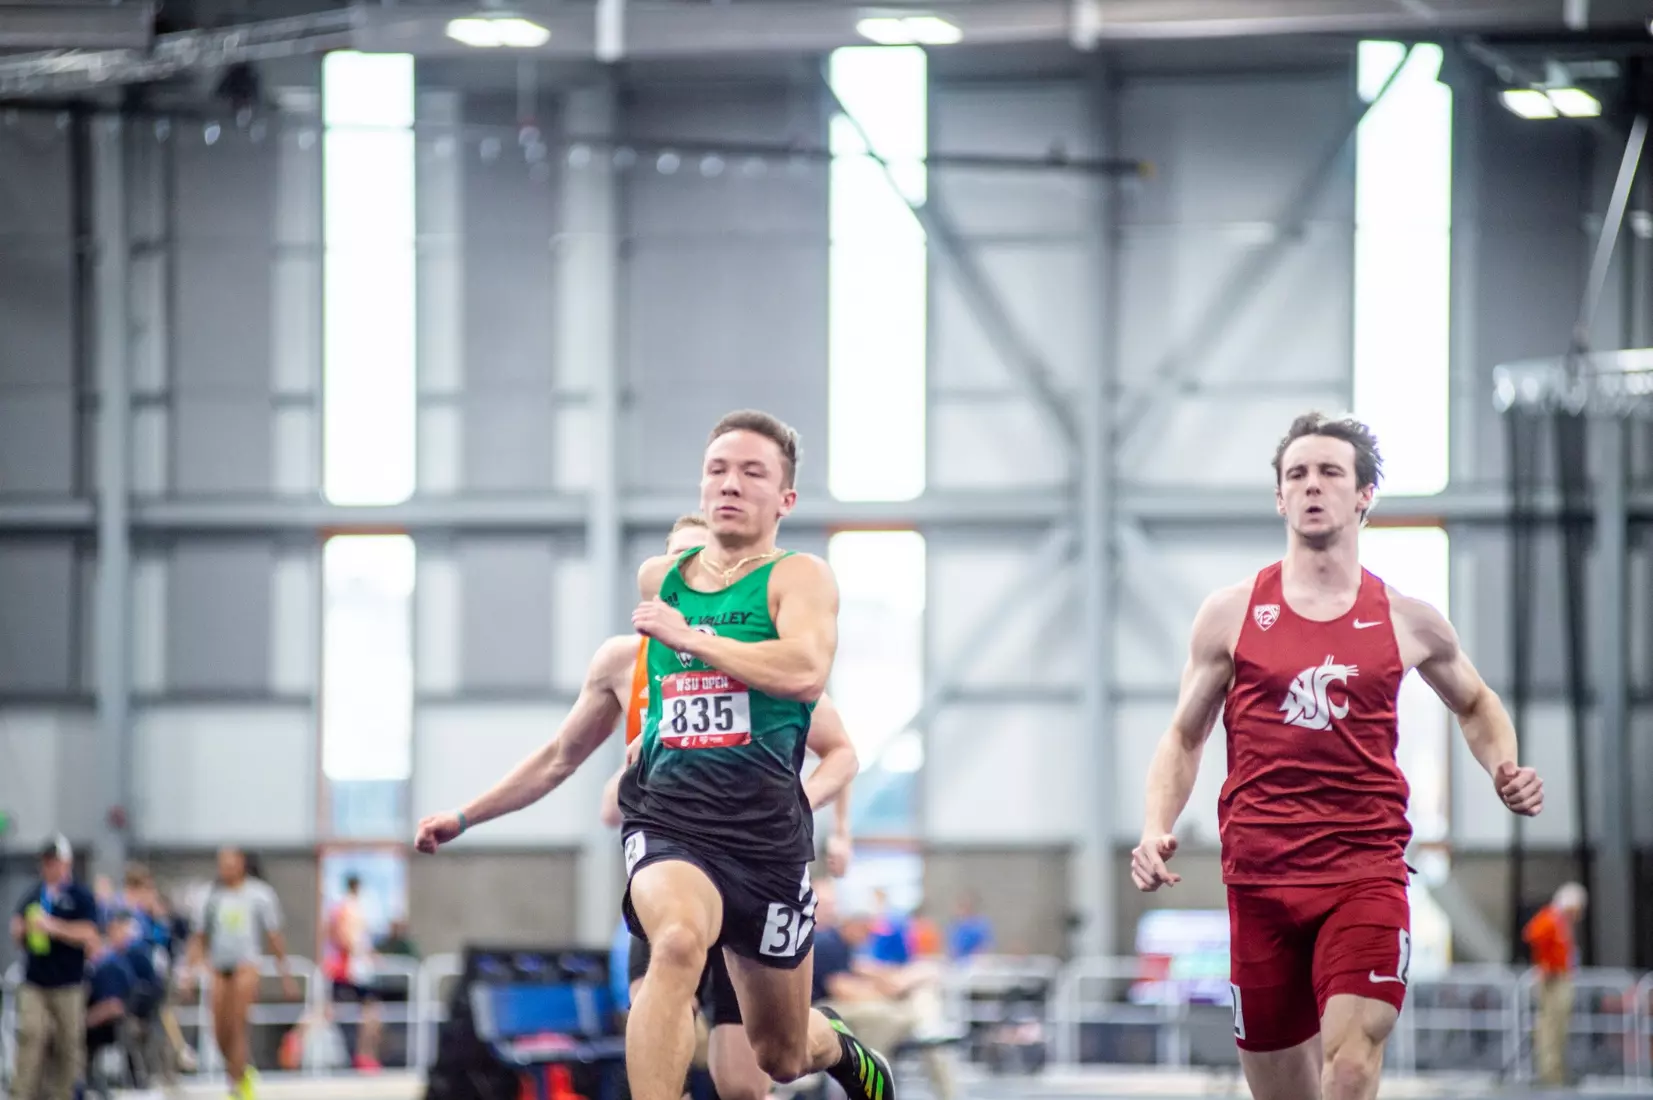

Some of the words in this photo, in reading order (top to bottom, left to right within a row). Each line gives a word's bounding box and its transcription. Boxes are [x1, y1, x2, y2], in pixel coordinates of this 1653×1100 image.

[698, 611, 753, 627] VALLEY
[1260, 613, 1273, 625] 12
[676, 677, 699, 692] WSU
[702, 675, 729, 690] OPEN
[671, 695, 734, 734] 835
[768, 906, 794, 954] 3
